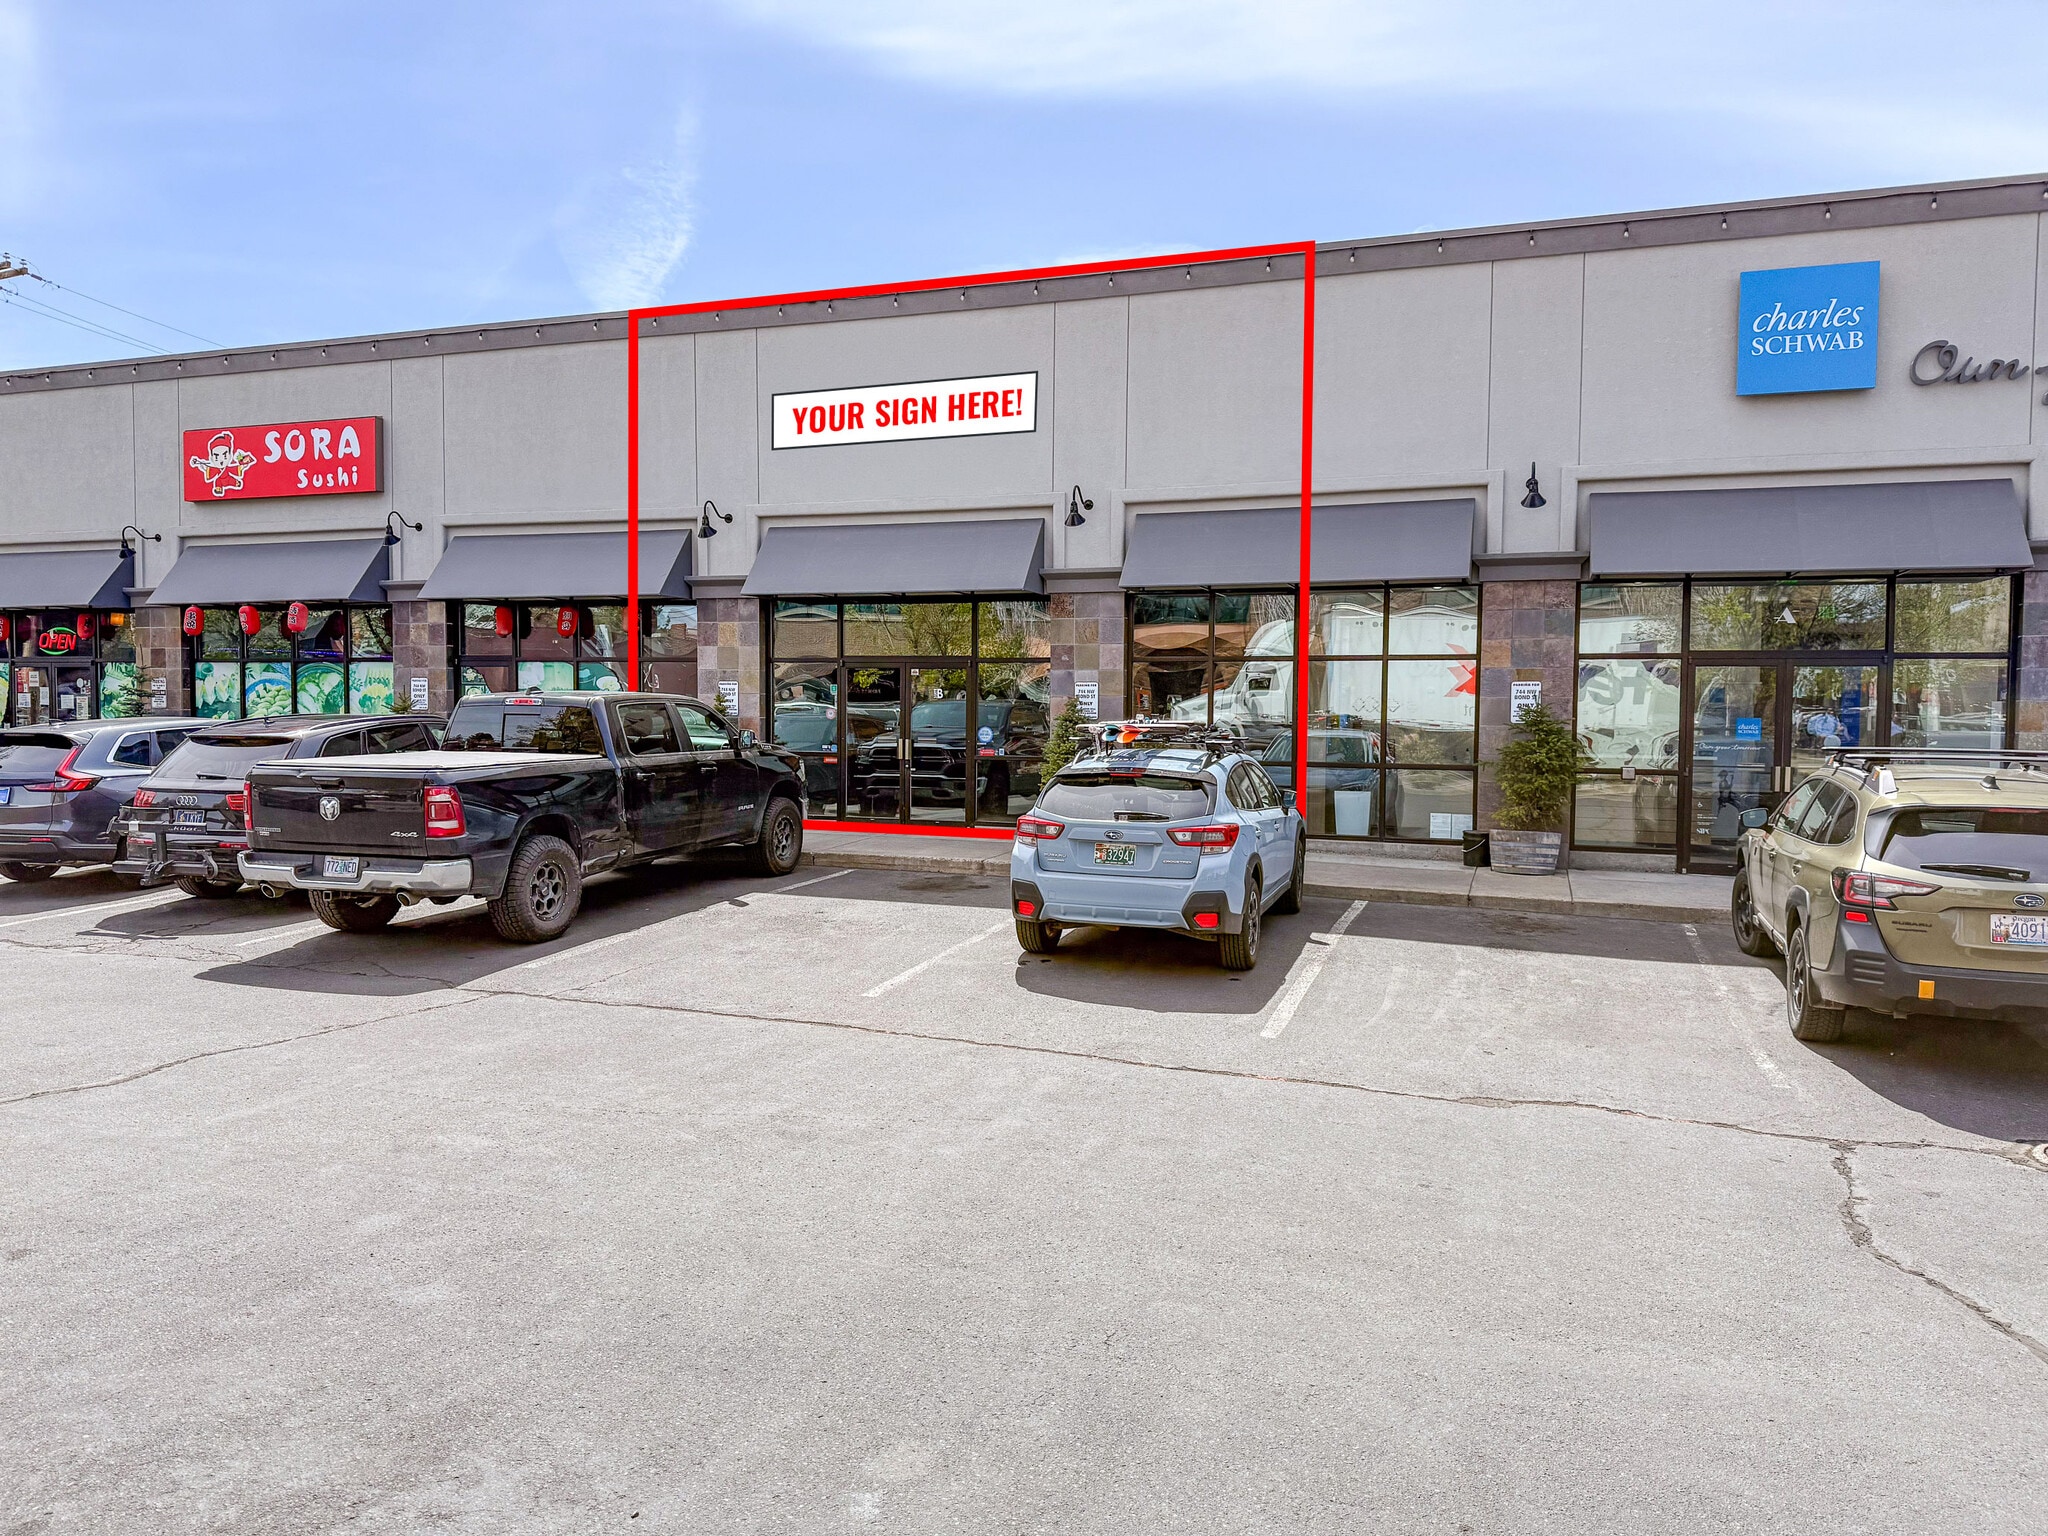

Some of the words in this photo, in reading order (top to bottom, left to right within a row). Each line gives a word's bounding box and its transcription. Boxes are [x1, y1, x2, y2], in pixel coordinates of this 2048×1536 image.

[1752, 298, 1864, 333] charles
[1751, 331, 1864, 356] SCHWAB
[1909, 339, 2030, 386] Own
[263, 425, 361, 464] SORA
[296, 465, 359, 488] Sushi
[1775, 607, 1797, 624] A
[38, 632, 77, 651] OPEN
[1107, 849, 1135, 862] 32947
[326, 860, 340, 873] 772
[1891, 920, 1932, 928] SUBARU
[2012, 915, 2036, 923] Oregon
